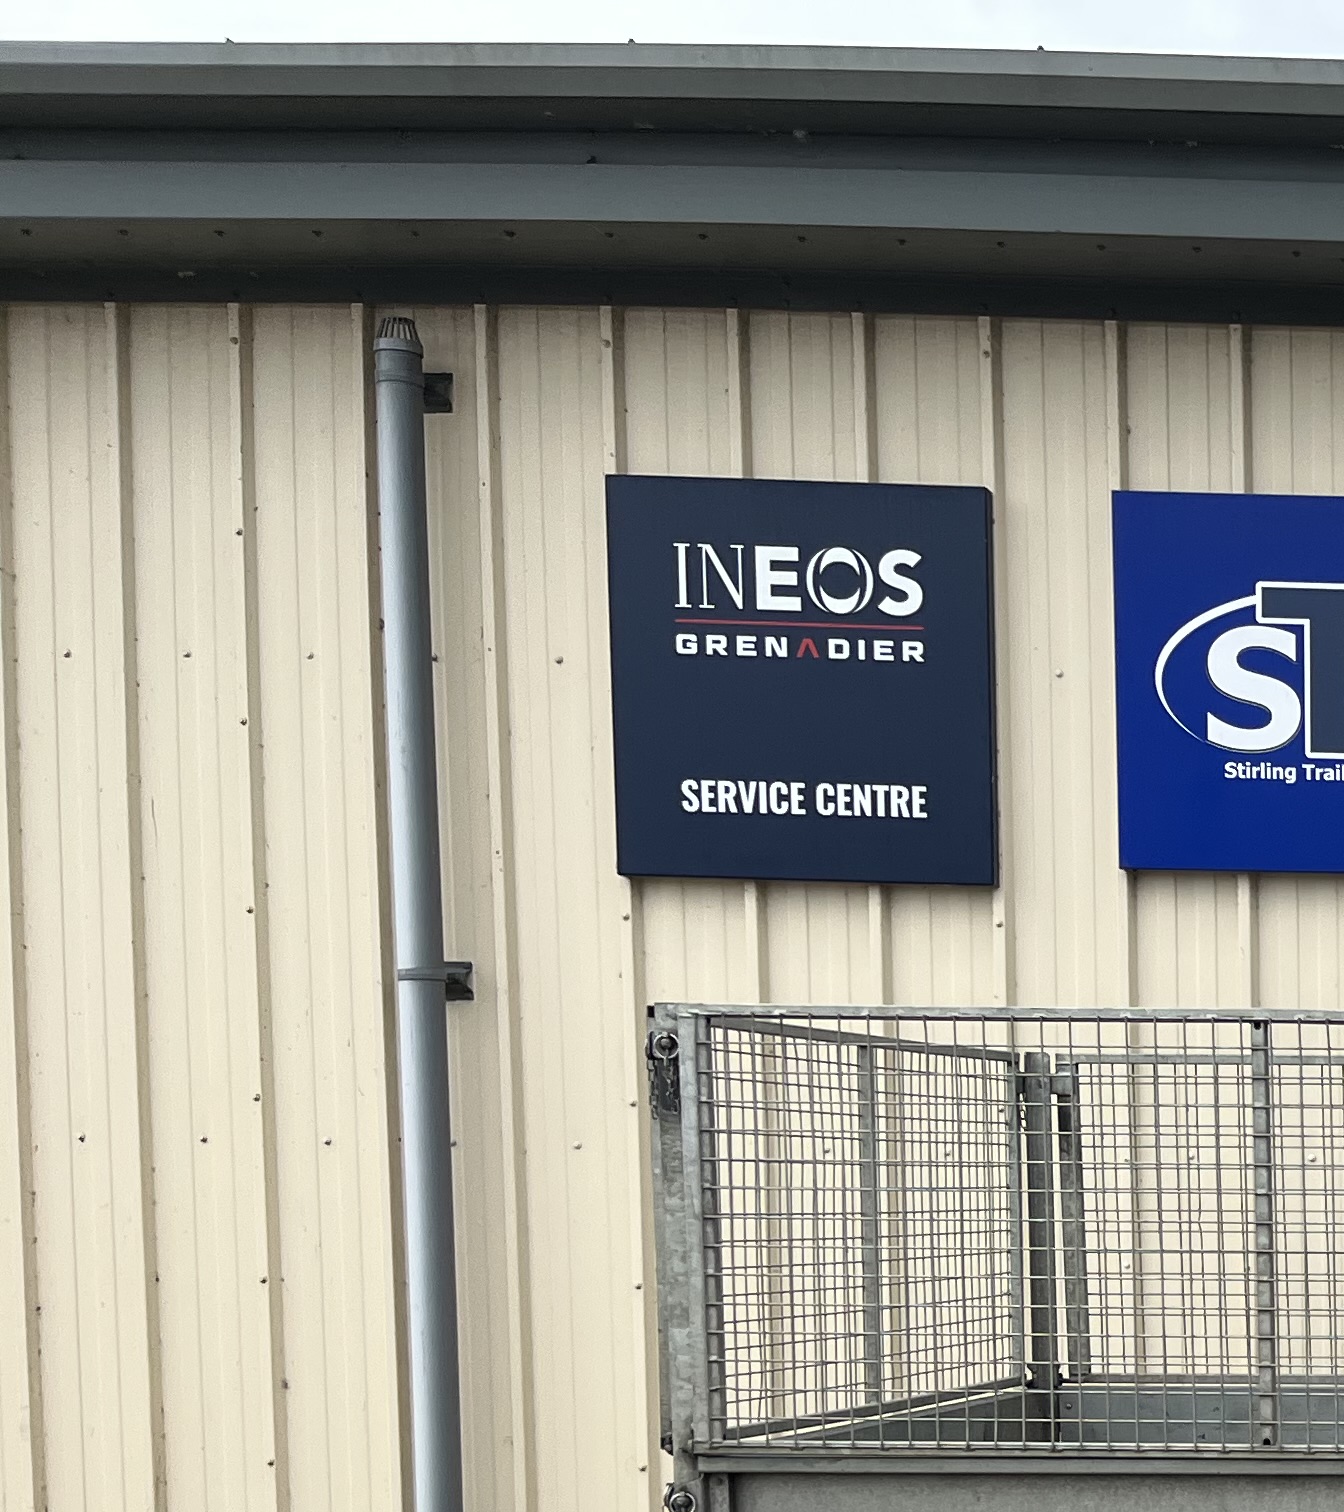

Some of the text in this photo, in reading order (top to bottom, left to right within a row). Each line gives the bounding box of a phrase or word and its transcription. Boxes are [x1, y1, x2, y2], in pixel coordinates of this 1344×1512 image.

[673, 543, 922, 616] INEOS
[676, 634, 924, 662] GRENADIER
[1224, 761, 1297, 783] Stirling
[681, 779, 927, 818] SERVICE CENTRE
